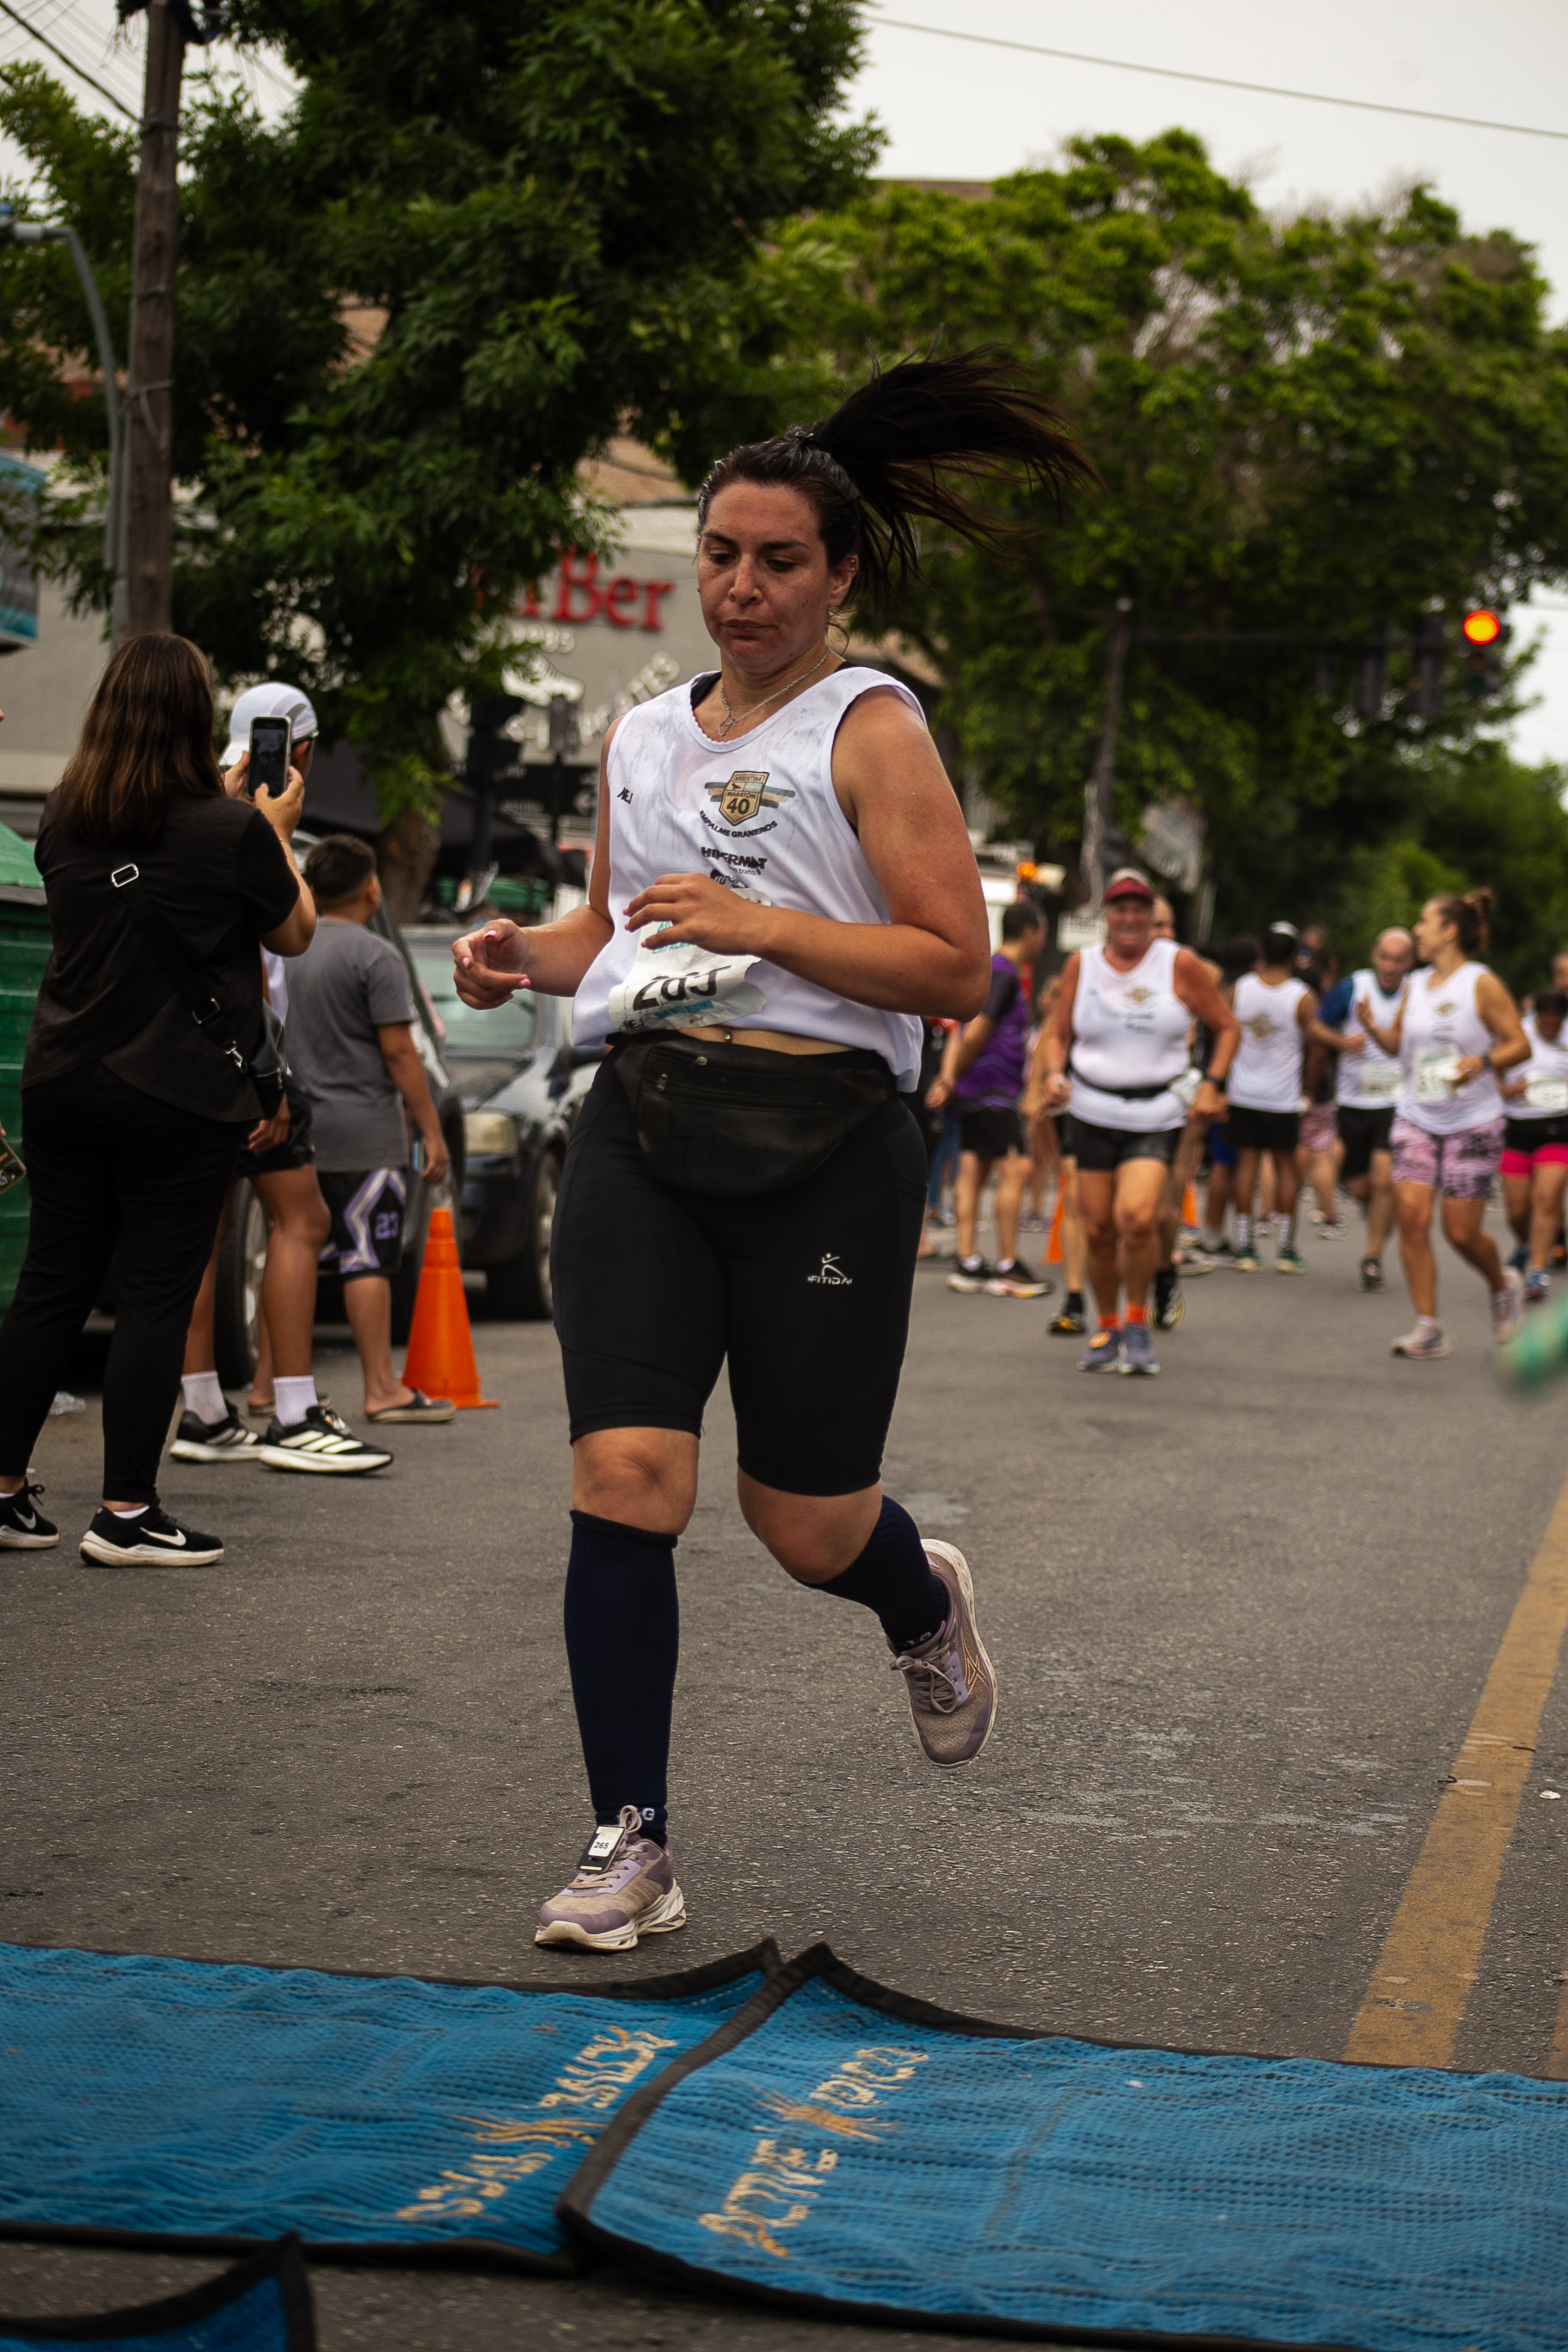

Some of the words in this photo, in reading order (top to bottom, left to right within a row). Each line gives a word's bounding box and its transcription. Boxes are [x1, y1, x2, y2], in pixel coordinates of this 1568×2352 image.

[726, 798, 750, 815] 40
[700, 811, 731, 837] EMPALME
[732, 820, 778, 838] GRANEROS
[593, 1841, 609, 1850] 265
